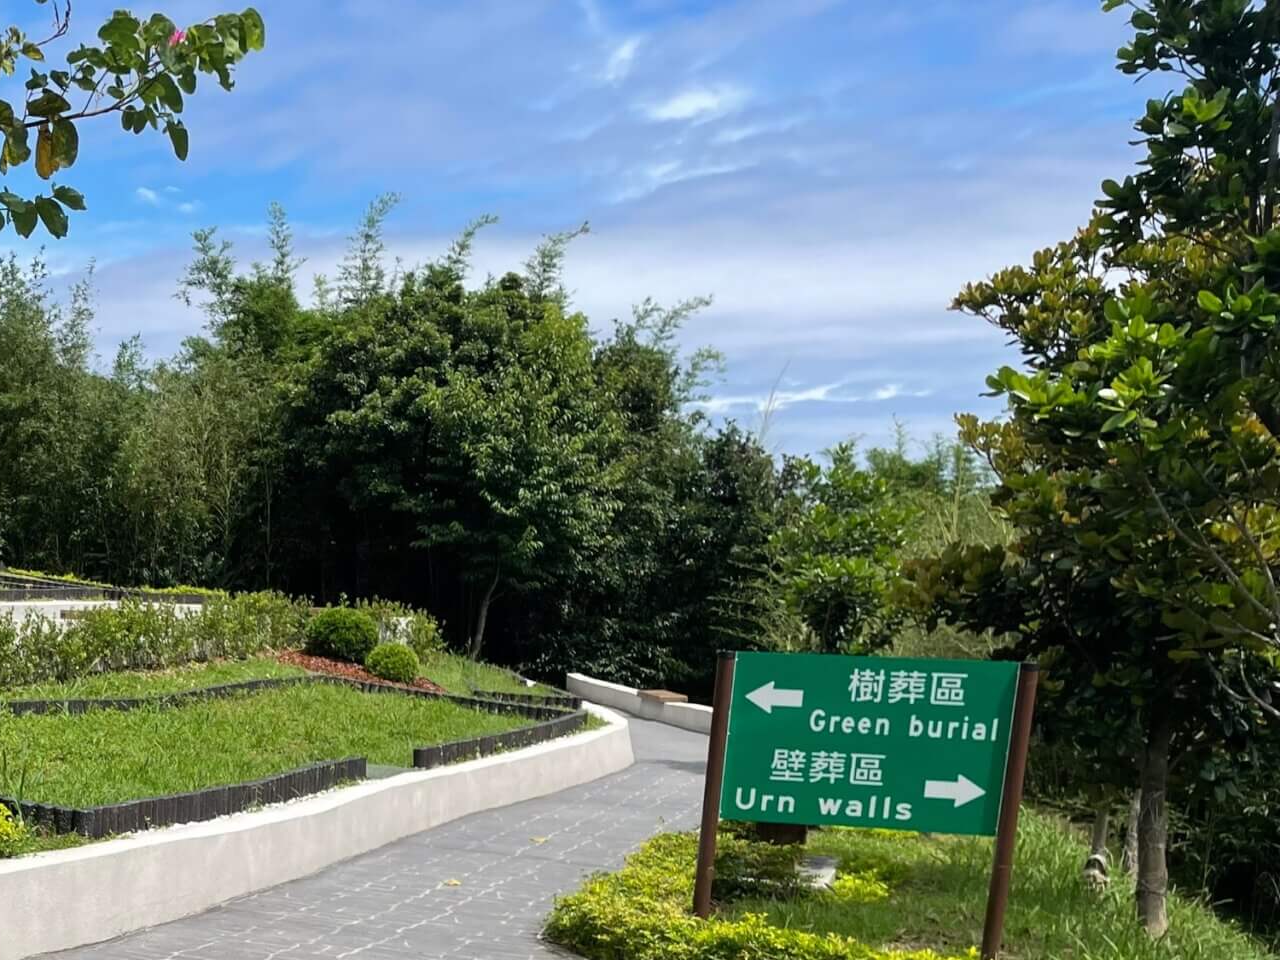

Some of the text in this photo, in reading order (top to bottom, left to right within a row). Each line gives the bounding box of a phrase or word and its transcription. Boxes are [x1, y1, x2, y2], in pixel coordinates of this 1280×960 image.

[848, 668, 969, 706] 樹葬區
[809, 709, 999, 742] Green burial
[769, 749, 886, 786] 壁葬區
[735, 787, 912, 821] Urn walls
